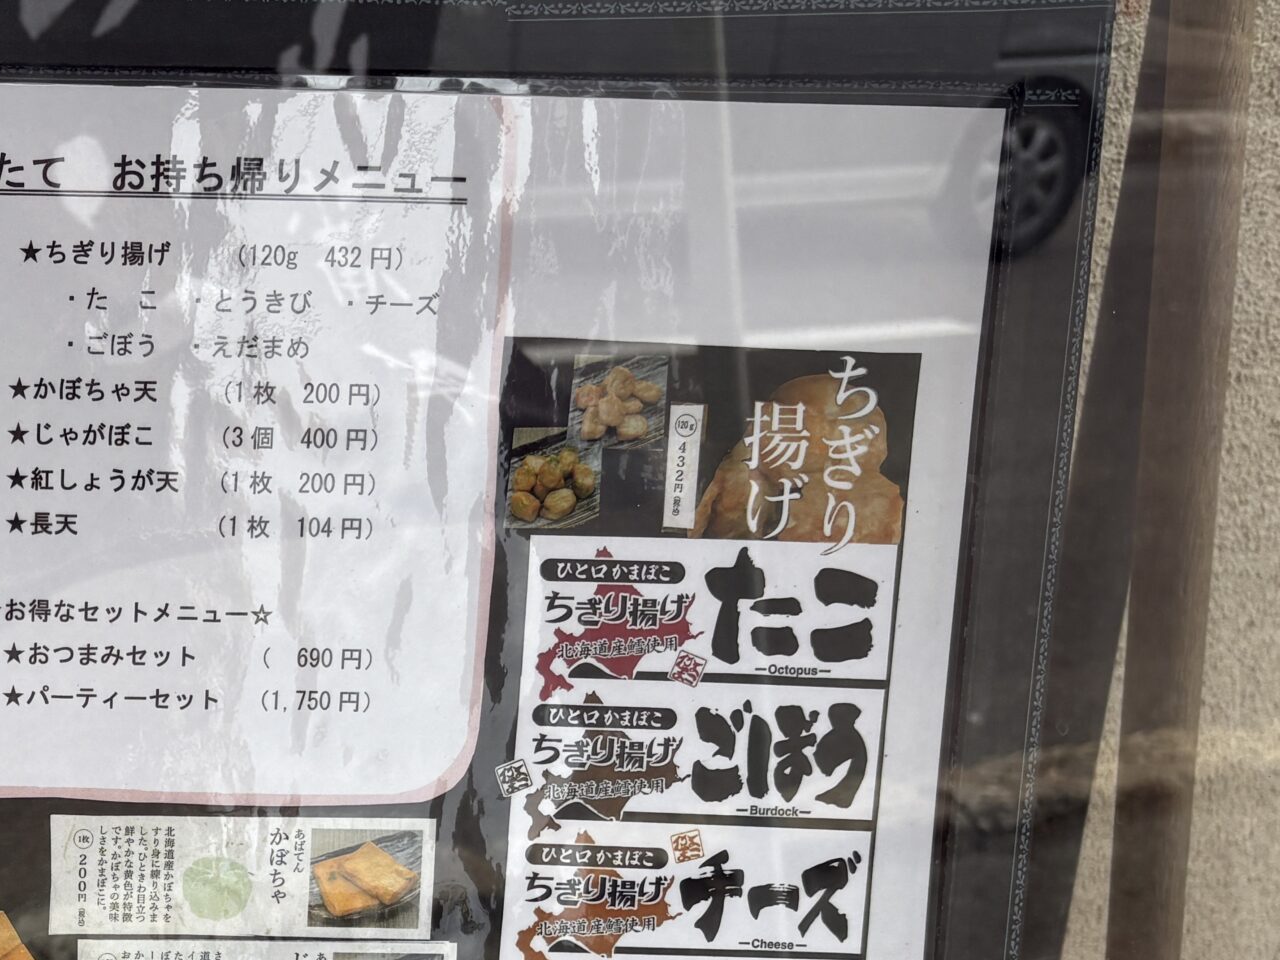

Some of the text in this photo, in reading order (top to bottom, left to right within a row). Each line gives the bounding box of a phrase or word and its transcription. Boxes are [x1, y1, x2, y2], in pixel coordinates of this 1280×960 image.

[112, 154, 467, 195] お持ち帰りメニュー
[545, 591, 691, 628] ちぎり揚げ
[705, 547, 878, 664] たこ
[532, 733, 680, 771] ちぎり揚げ
[691, 699, 867, 808] ごぼう
[269, 828, 289, 904] かぼちゃ
[525, 872, 667, 909] ちぎり揚げ
[680, 850, 862, 942] チーズ
